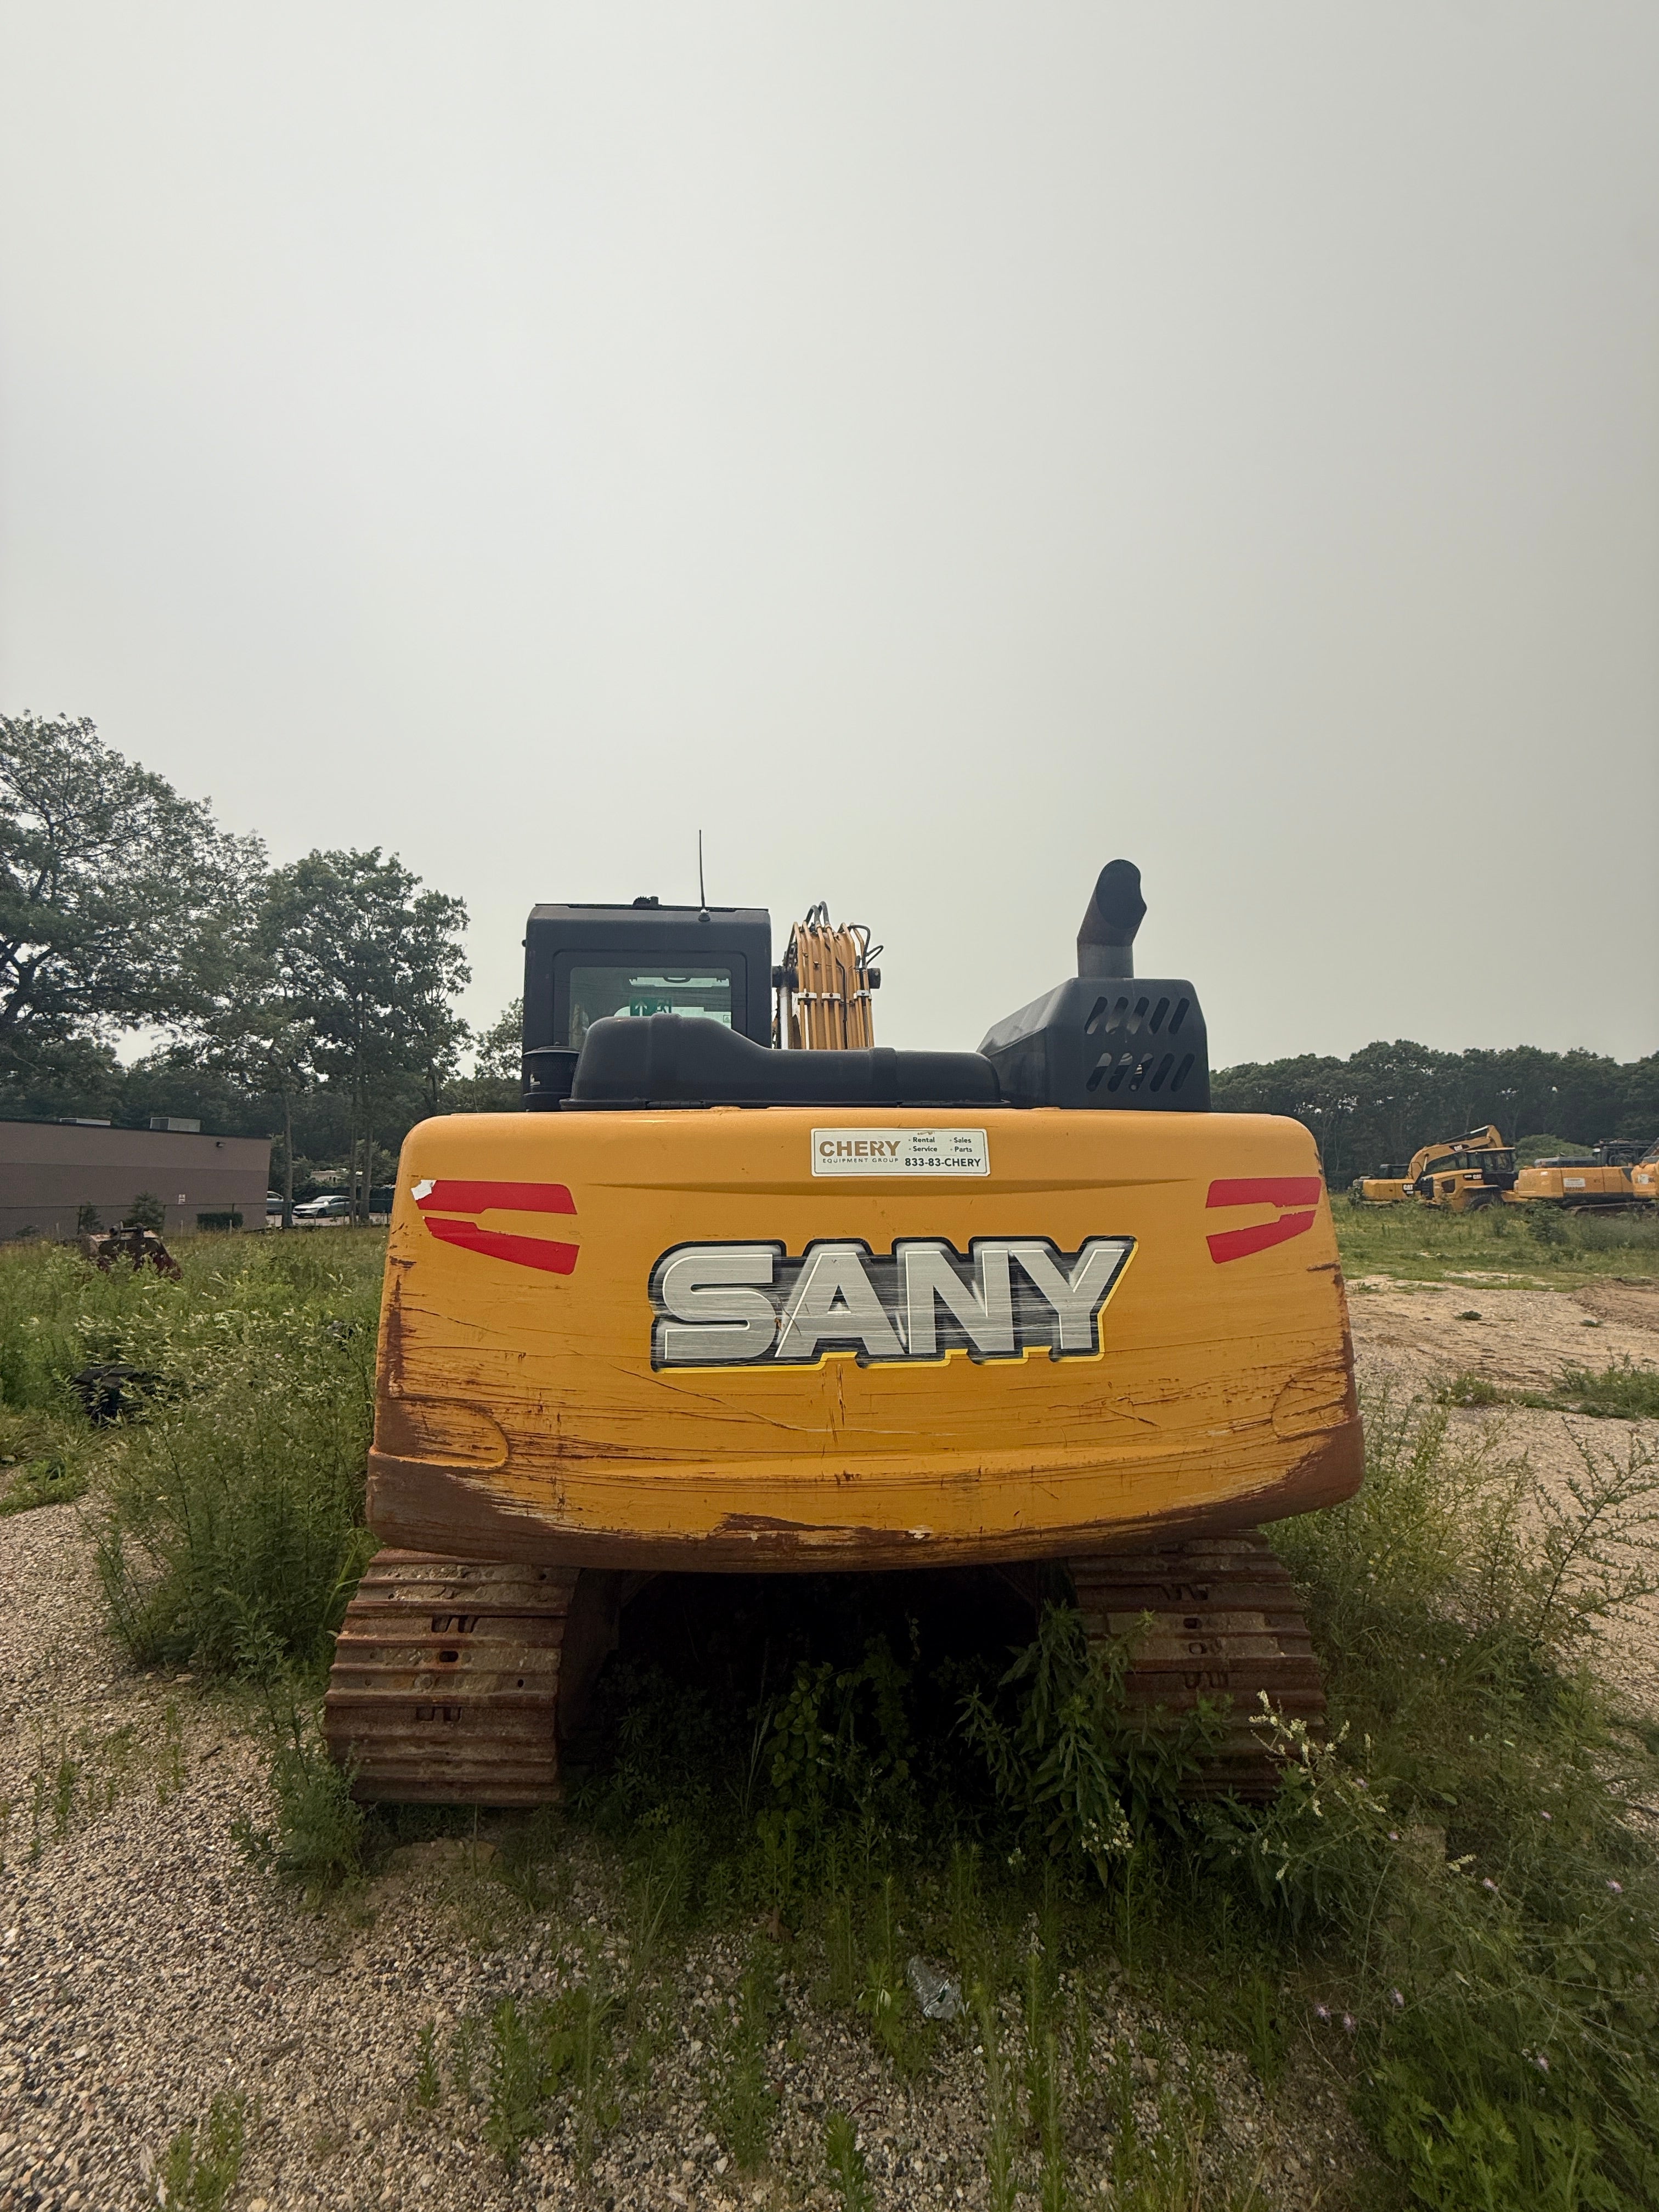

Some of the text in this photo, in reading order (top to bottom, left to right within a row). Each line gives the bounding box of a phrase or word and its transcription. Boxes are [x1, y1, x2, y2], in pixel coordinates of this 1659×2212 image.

[819, 1141, 901, 1157] CHERY
[905, 1158, 981, 1167] 833-83-CHERY
[660, 1246, 1128, 1361] SANY
